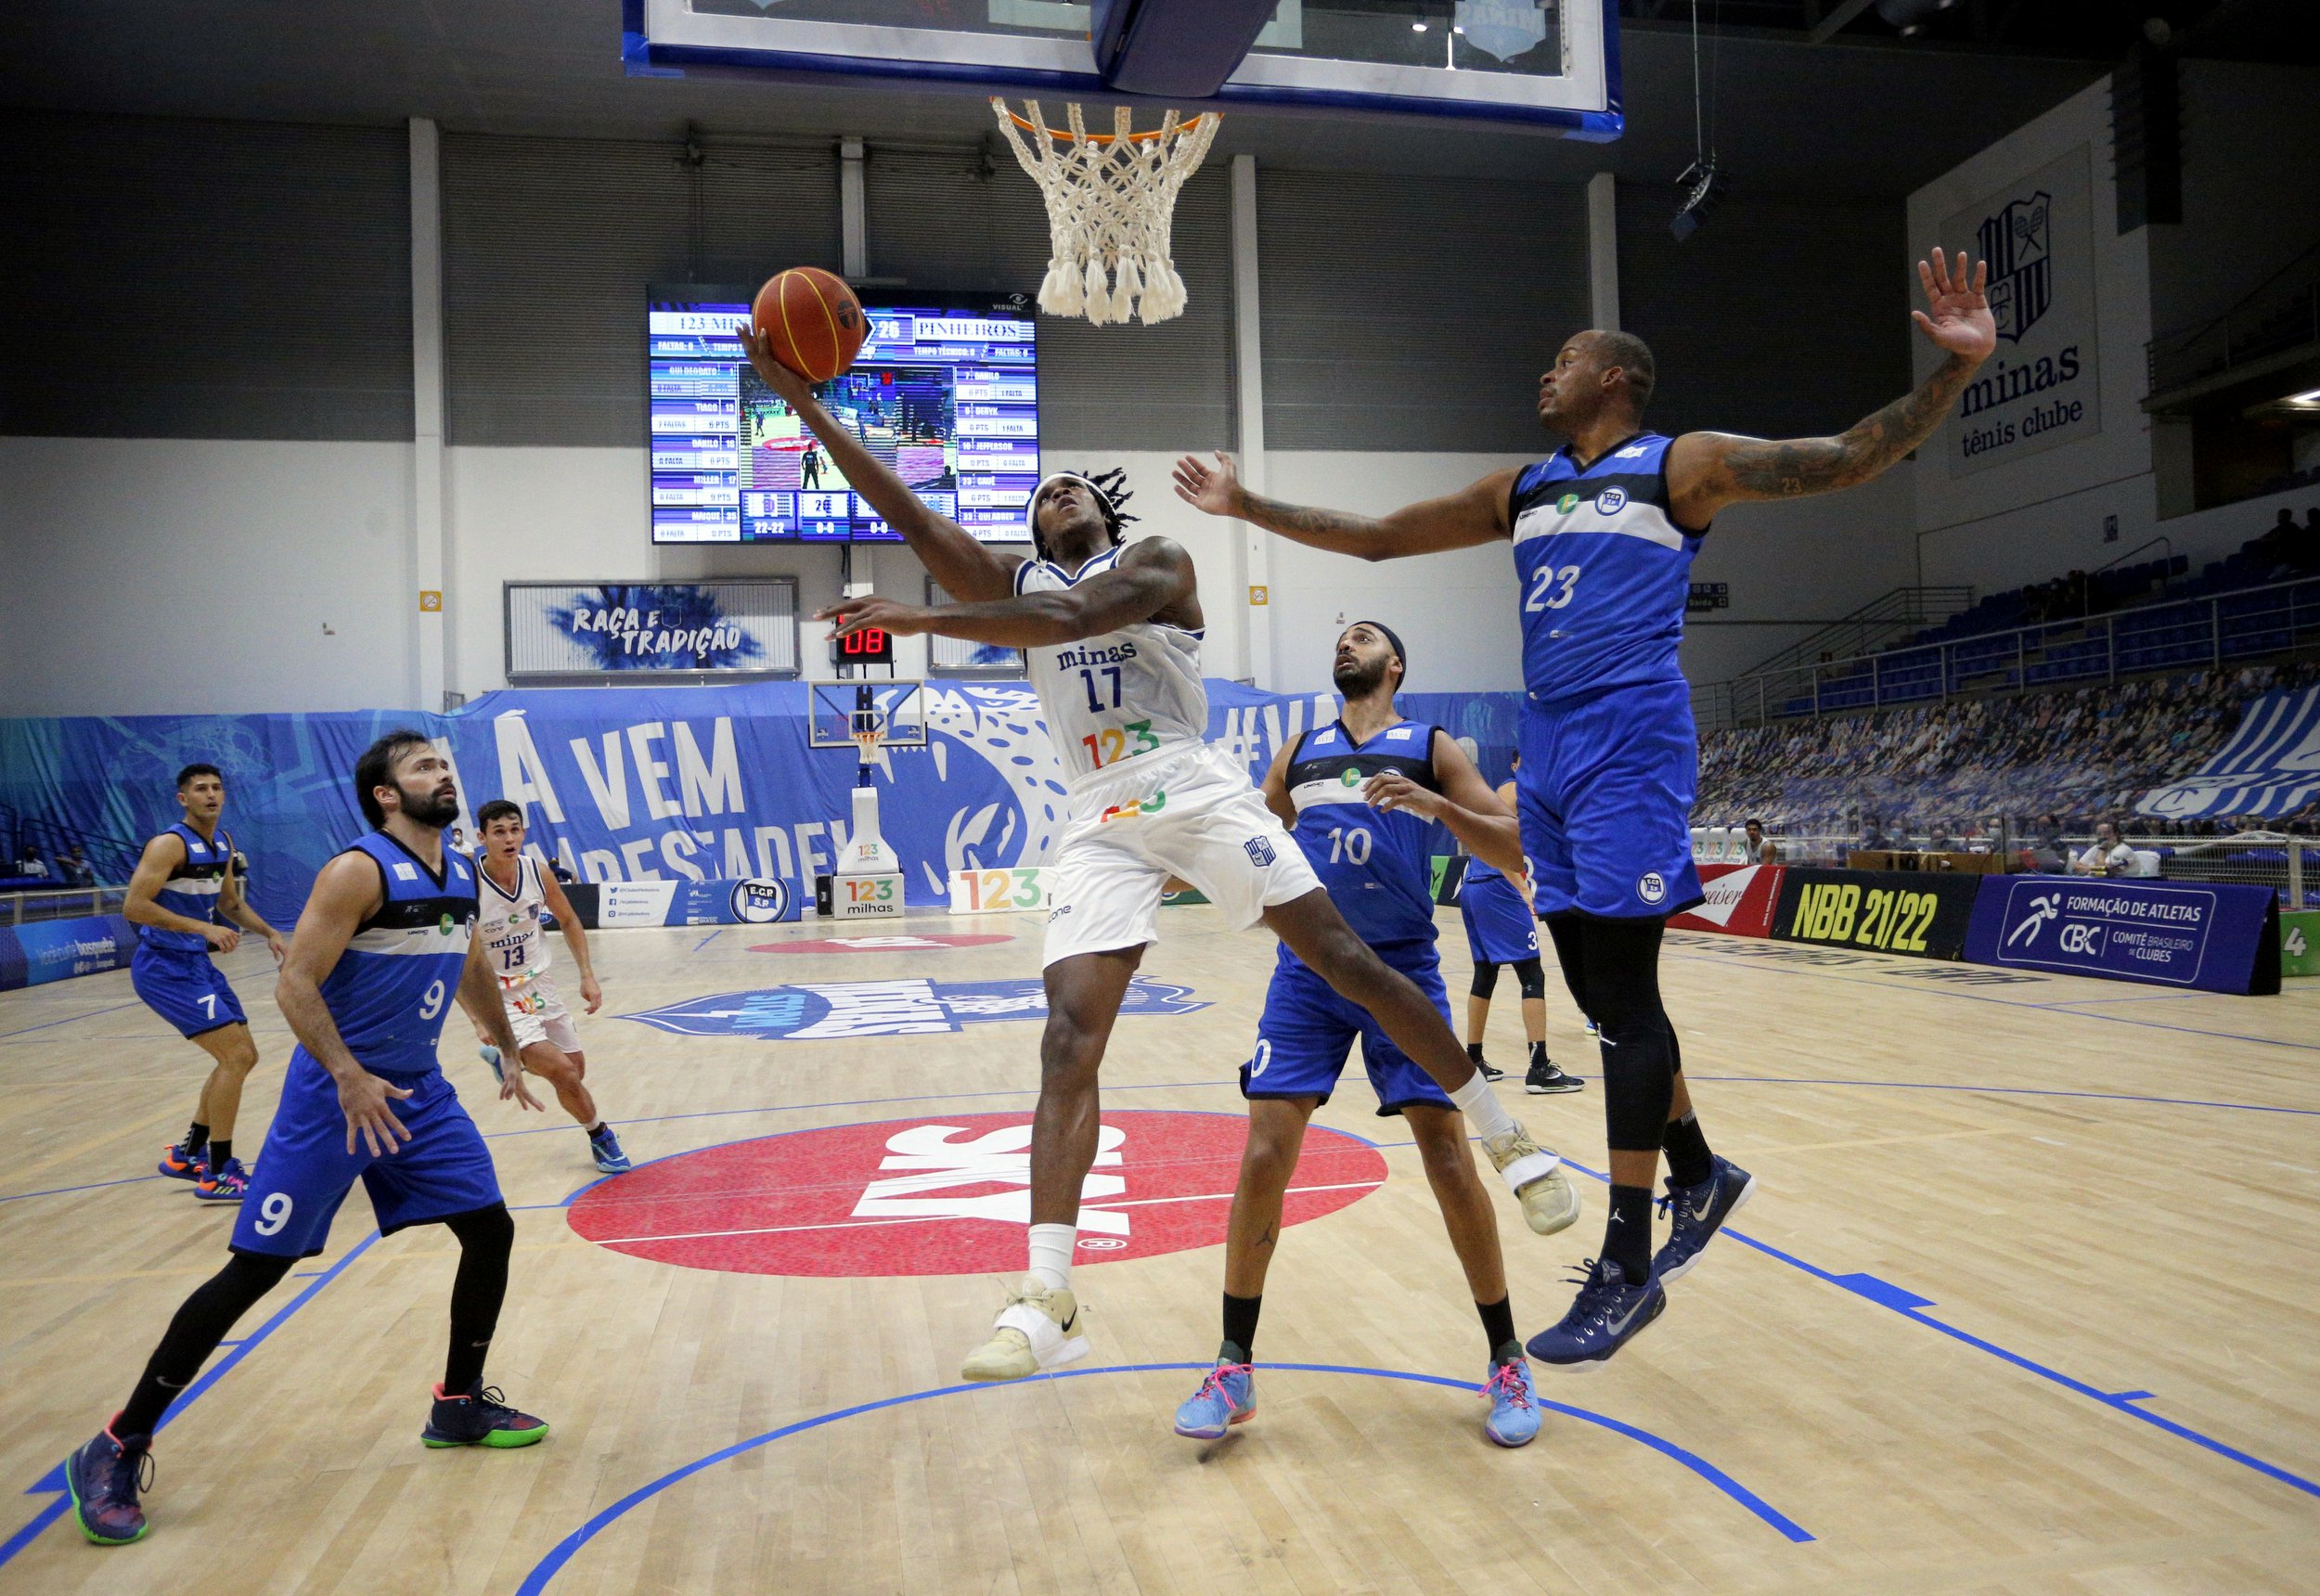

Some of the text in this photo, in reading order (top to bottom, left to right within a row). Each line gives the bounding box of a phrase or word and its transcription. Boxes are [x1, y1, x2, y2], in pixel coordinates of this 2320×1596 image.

[679, 317, 705, 330] 123
[878, 320, 900, 339] 26
[919, 322, 1017, 337] PINHEIROS
[657, 341, 687, 351] FALTAS:
[713, 343, 739, 352] TEMPO
[914, 346, 937, 356] TEMPO
[938, 345, 970, 356] TÉCNICO:
[994, 348, 1022, 357] FALTAS:
[974, 372, 1000, 380] DANILO
[1960, 345, 2080, 418] minas
[974, 389, 988, 397] PTS
[695, 403, 718, 412] TIAGO
[974, 406, 999, 416] DERYK
[664, 419, 687, 428] FALTAS
[715, 420, 729, 429] PTS
[1961, 399, 2083, 458] tênis clube
[692, 439, 719, 448] DANILO
[976, 442, 1013, 451] JEFFERSON
[716, 457, 730, 465] PTS
[977, 459, 990, 468] PTS
[728, 475, 737, 484] 17
[962, 477, 972, 485] 23
[717, 494, 731, 502] PTS
[977, 494, 991, 502] PTS
[691, 511, 737, 521] MAIQUE 35
[666, 530, 685, 538] FALTA
[718, 530, 732, 538] PTS
[754, 521, 785, 534] 22-22
[978, 529, 992, 538] PTS
[1010, 530, 1027, 538] FALTA
[1525, 565, 1580, 612] 23
[573, 607, 661, 639] RAÇA E
[622, 618, 741, 660] TRADIÇÃO
[845, 628, 883, 654] 08
[1057, 641, 1138, 672] minas
[1080, 666, 1123, 714] 17
[1082, 719, 1160, 771] 123
[569, 715, 746, 831] VEM
[857, 843, 879, 856] 123
[1327, 827, 1373, 866] 10
[846, 880, 893, 903] 123
[960, 869, 1041, 910] 123
[847, 903, 894, 915] milhas
[1791, 883, 1938, 952] NBB 21/22
[2066, 895, 2203, 922] FORMAÇÃO DE ATLETAS
[490, 930, 535, 948] minas
[1527, 931, 1539, 951] 3
[2059, 923, 2102, 955] CBC
[2112, 931, 2194, 952] COMITÊ BRASILEIRO
[2283, 927, 2307, 957] 4
[503, 945, 525, 970] 13
[2135, 948, 2172, 963] CLUBES
[197, 993, 216, 1021] 7
[419, 979, 445, 1021] 9
[784, 978, 953, 1039] MINAS
[731, 993, 808, 1031] STORM
[253, 1191, 293, 1237] 9
